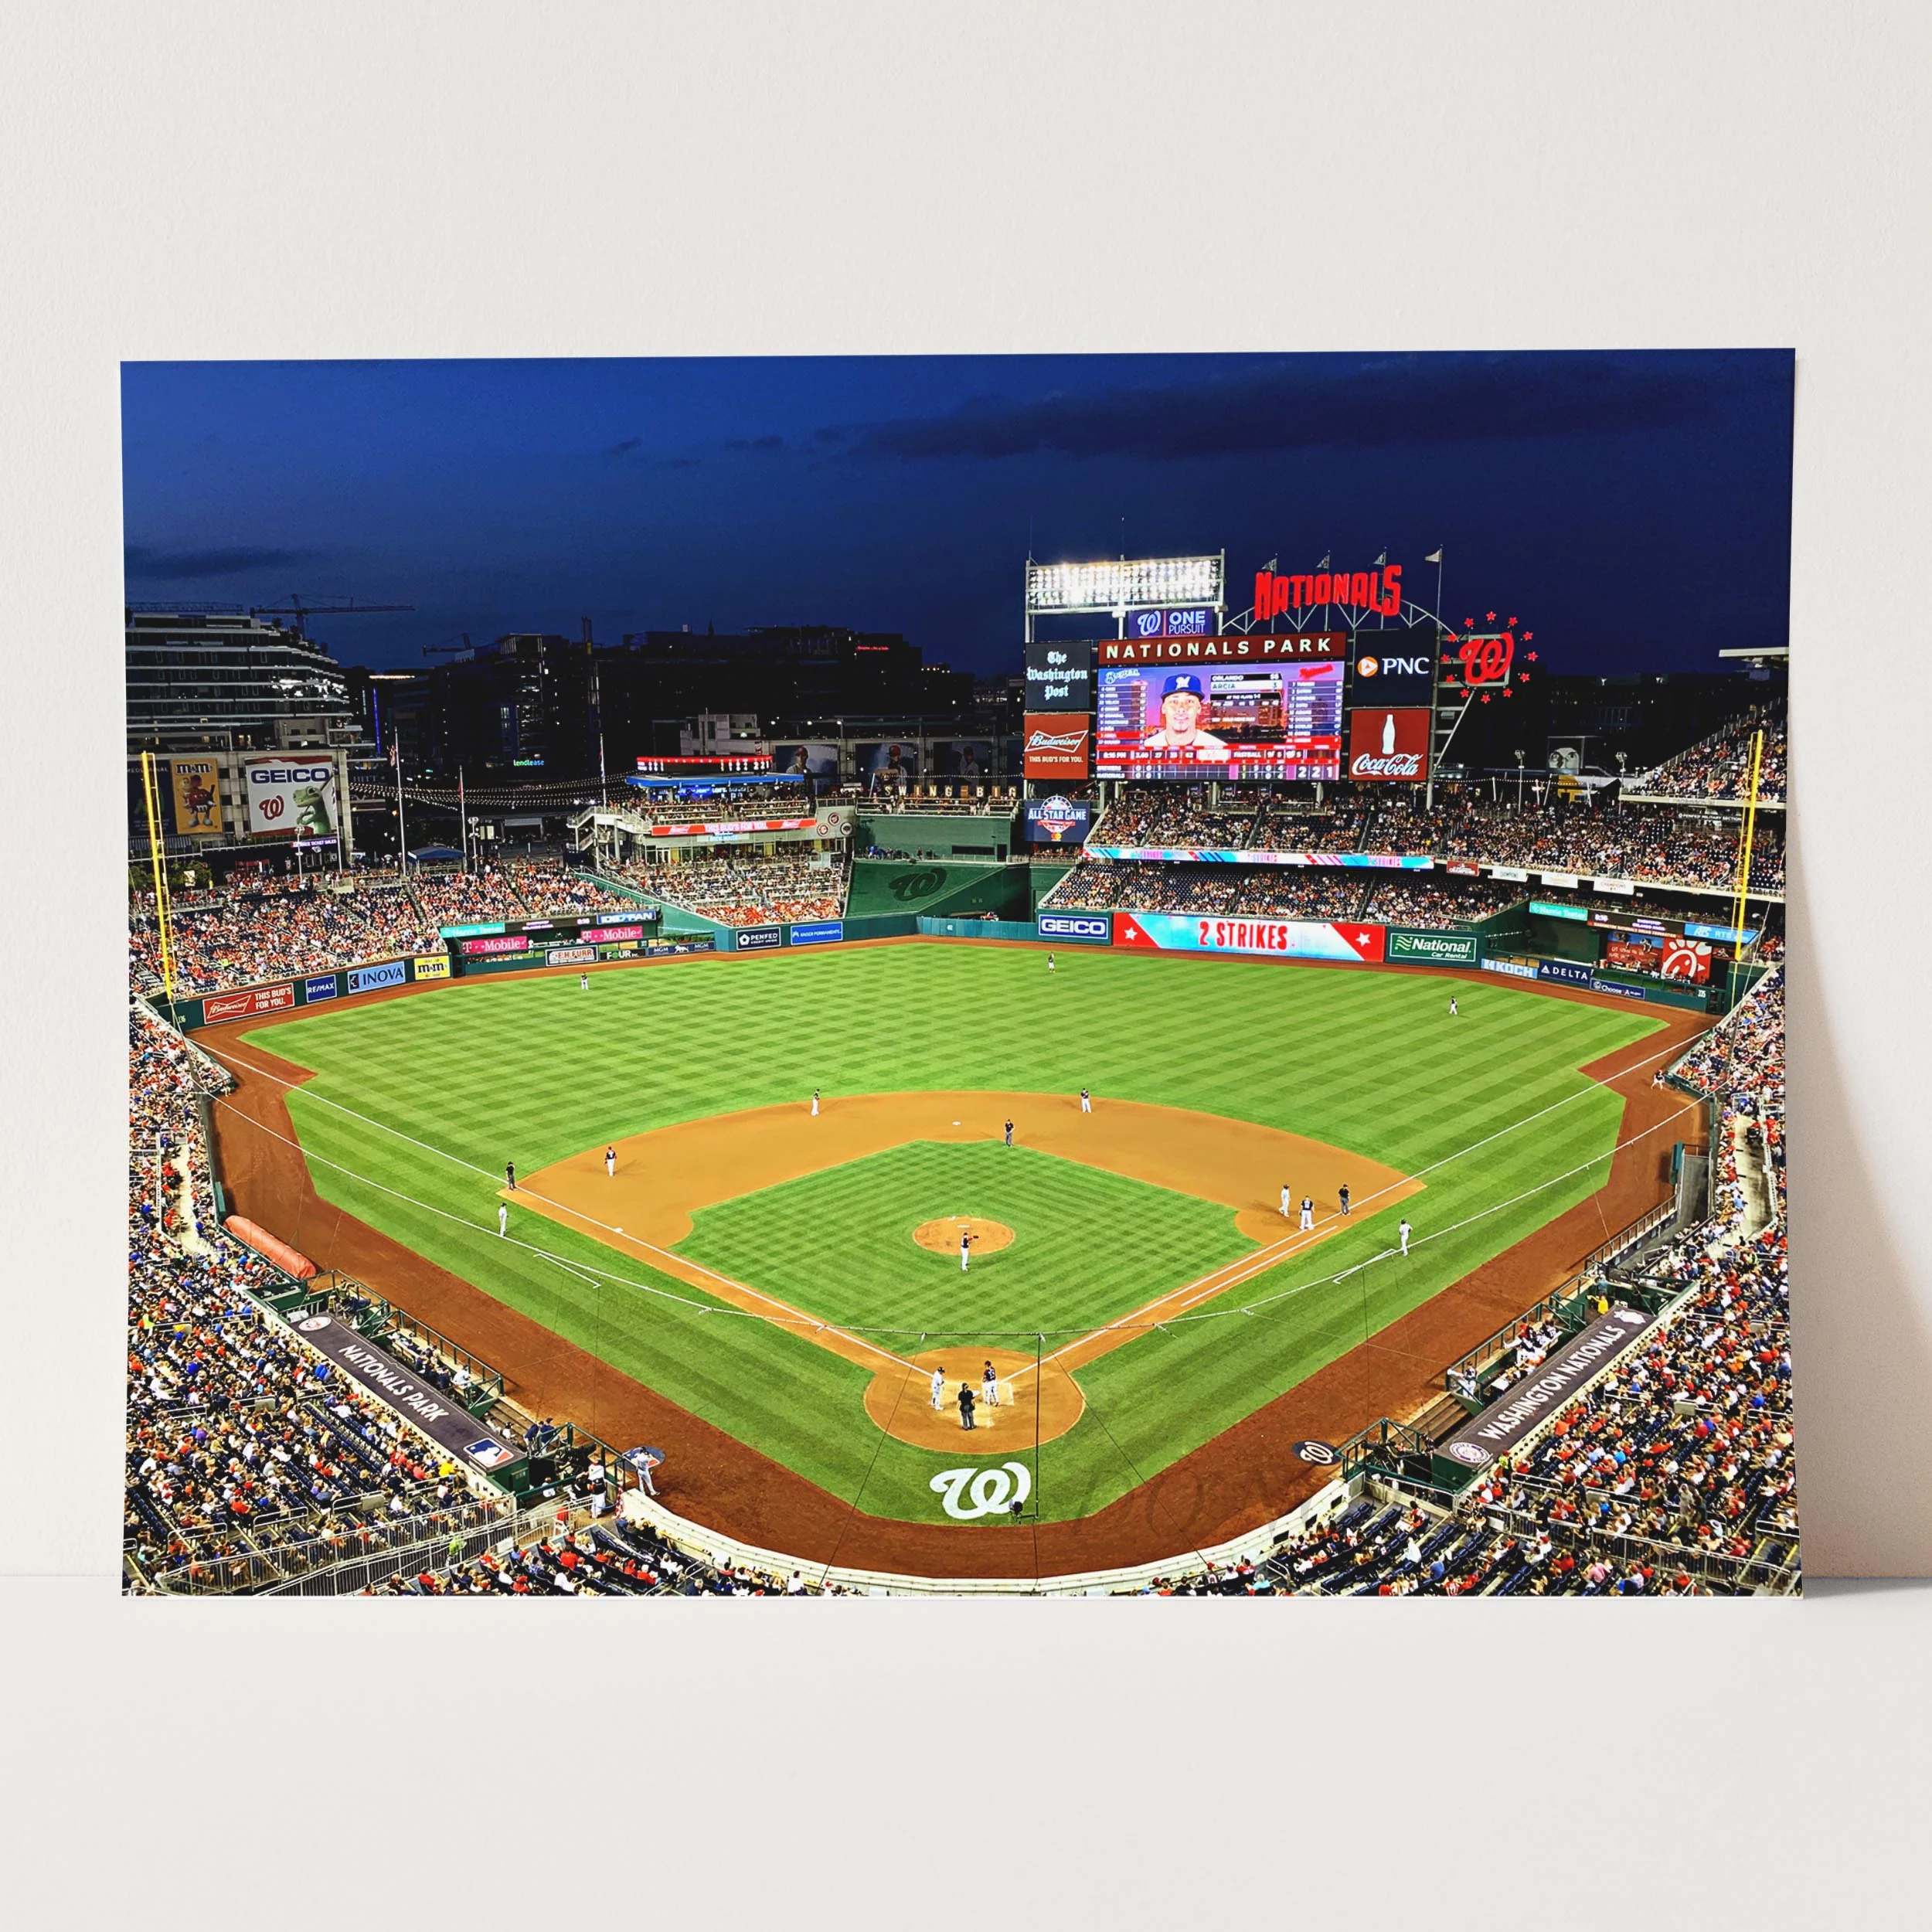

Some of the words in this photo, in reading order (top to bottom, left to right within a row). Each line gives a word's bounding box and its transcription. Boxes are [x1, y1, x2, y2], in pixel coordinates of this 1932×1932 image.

[1254, 565, 1402, 621] NATIONALS
[1168, 611, 1206, 625] ONE
[1168, 622, 1205, 634] PURSUIT
[1106, 641, 1250, 659] NATIONALS
[1264, 638, 1331, 654] PARK
[1047, 651, 1067, 665] The
[1382, 657, 1430, 675] PNC
[1459, 632, 1514, 684] W
[1026, 666, 1088, 682] Washington
[1044, 685, 1069, 701] Post
[1029, 735, 1083, 747] Budweiser
[1298, 767, 1307, 778] 2
[1311, 767, 1321, 778] 2
[1352, 753, 1423, 776] Coca-Cola
[251, 767, 330, 784] GEICO
[259, 794, 284, 821] W
[1028, 808, 1043, 820] ALL
[1043, 809, 1063, 820] STAR
[1065, 810, 1087, 820] GAME
[1041, 919, 1106, 935] GEICO
[1199, 921, 1209, 946] 2
[1216, 922, 1287, 950] STRIKES
[572, 949, 593, 958] FURR
[607, 950, 631, 960] FOUR
[362, 967, 404, 985] INOVA
[1495, 962, 1534, 978] KOCH
[1553, 967, 1588, 980] DELTA
[255, 991, 270, 1001] THIS
[271, 987, 291, 996] BUD'S
[308, 982, 335, 994] RE/MAX
[210, 1002, 247, 1014] Budweiser
[255, 1000, 269, 1010] FOR
[270, 997, 286, 1006] YOU.
[338, 1344, 414, 1396] NATIONALS
[403, 1391, 449, 1422] PARK
[1478, 1366, 1563, 1440] WASHINGTON
[1559, 1325, 1626, 1386] NATIONALS
[930, 1461, 1032, 1520] W
